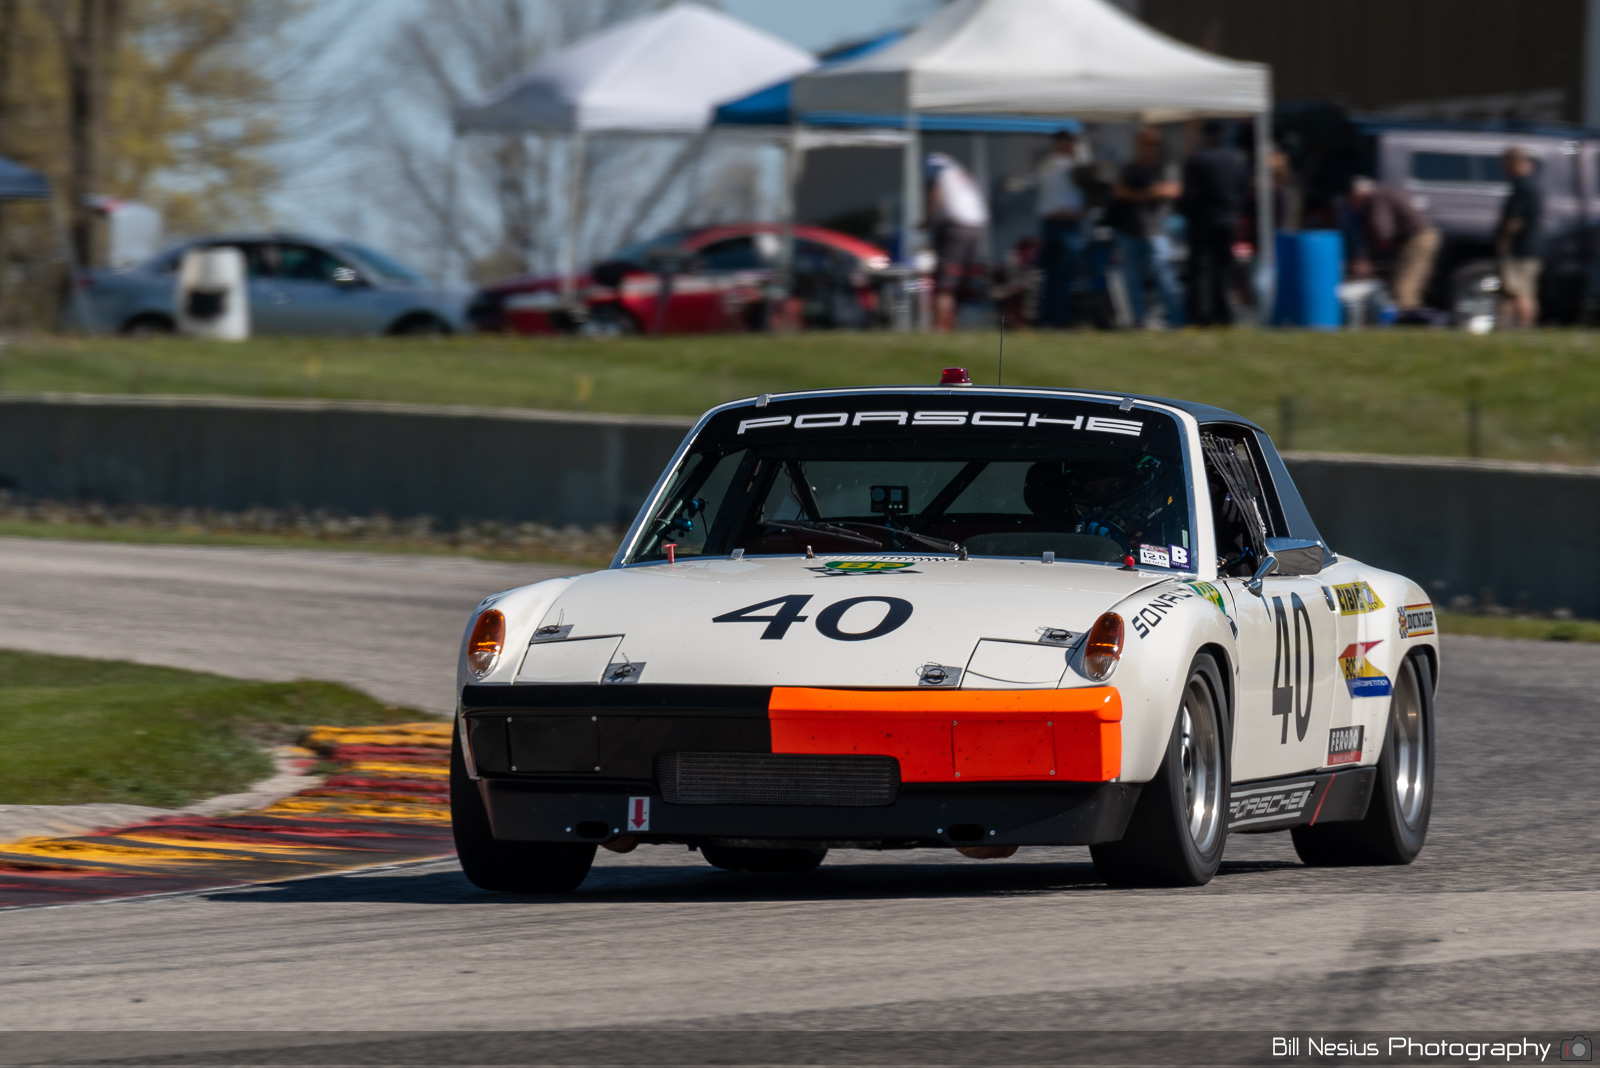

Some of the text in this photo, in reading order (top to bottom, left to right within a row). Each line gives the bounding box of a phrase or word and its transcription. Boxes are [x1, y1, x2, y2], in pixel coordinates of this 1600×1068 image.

[737, 411, 1143, 436] PORSCHE
[837, 561, 905, 570] BP
[1172, 545, 1188, 564] B
[712, 594, 914, 642] 40
[1407, 610, 1433, 630] DUNLOP
[1272, 591, 1315, 745] 40
[1330, 728, 1359, 752] FERODO
[1229, 790, 1304, 819] PORSCHE
